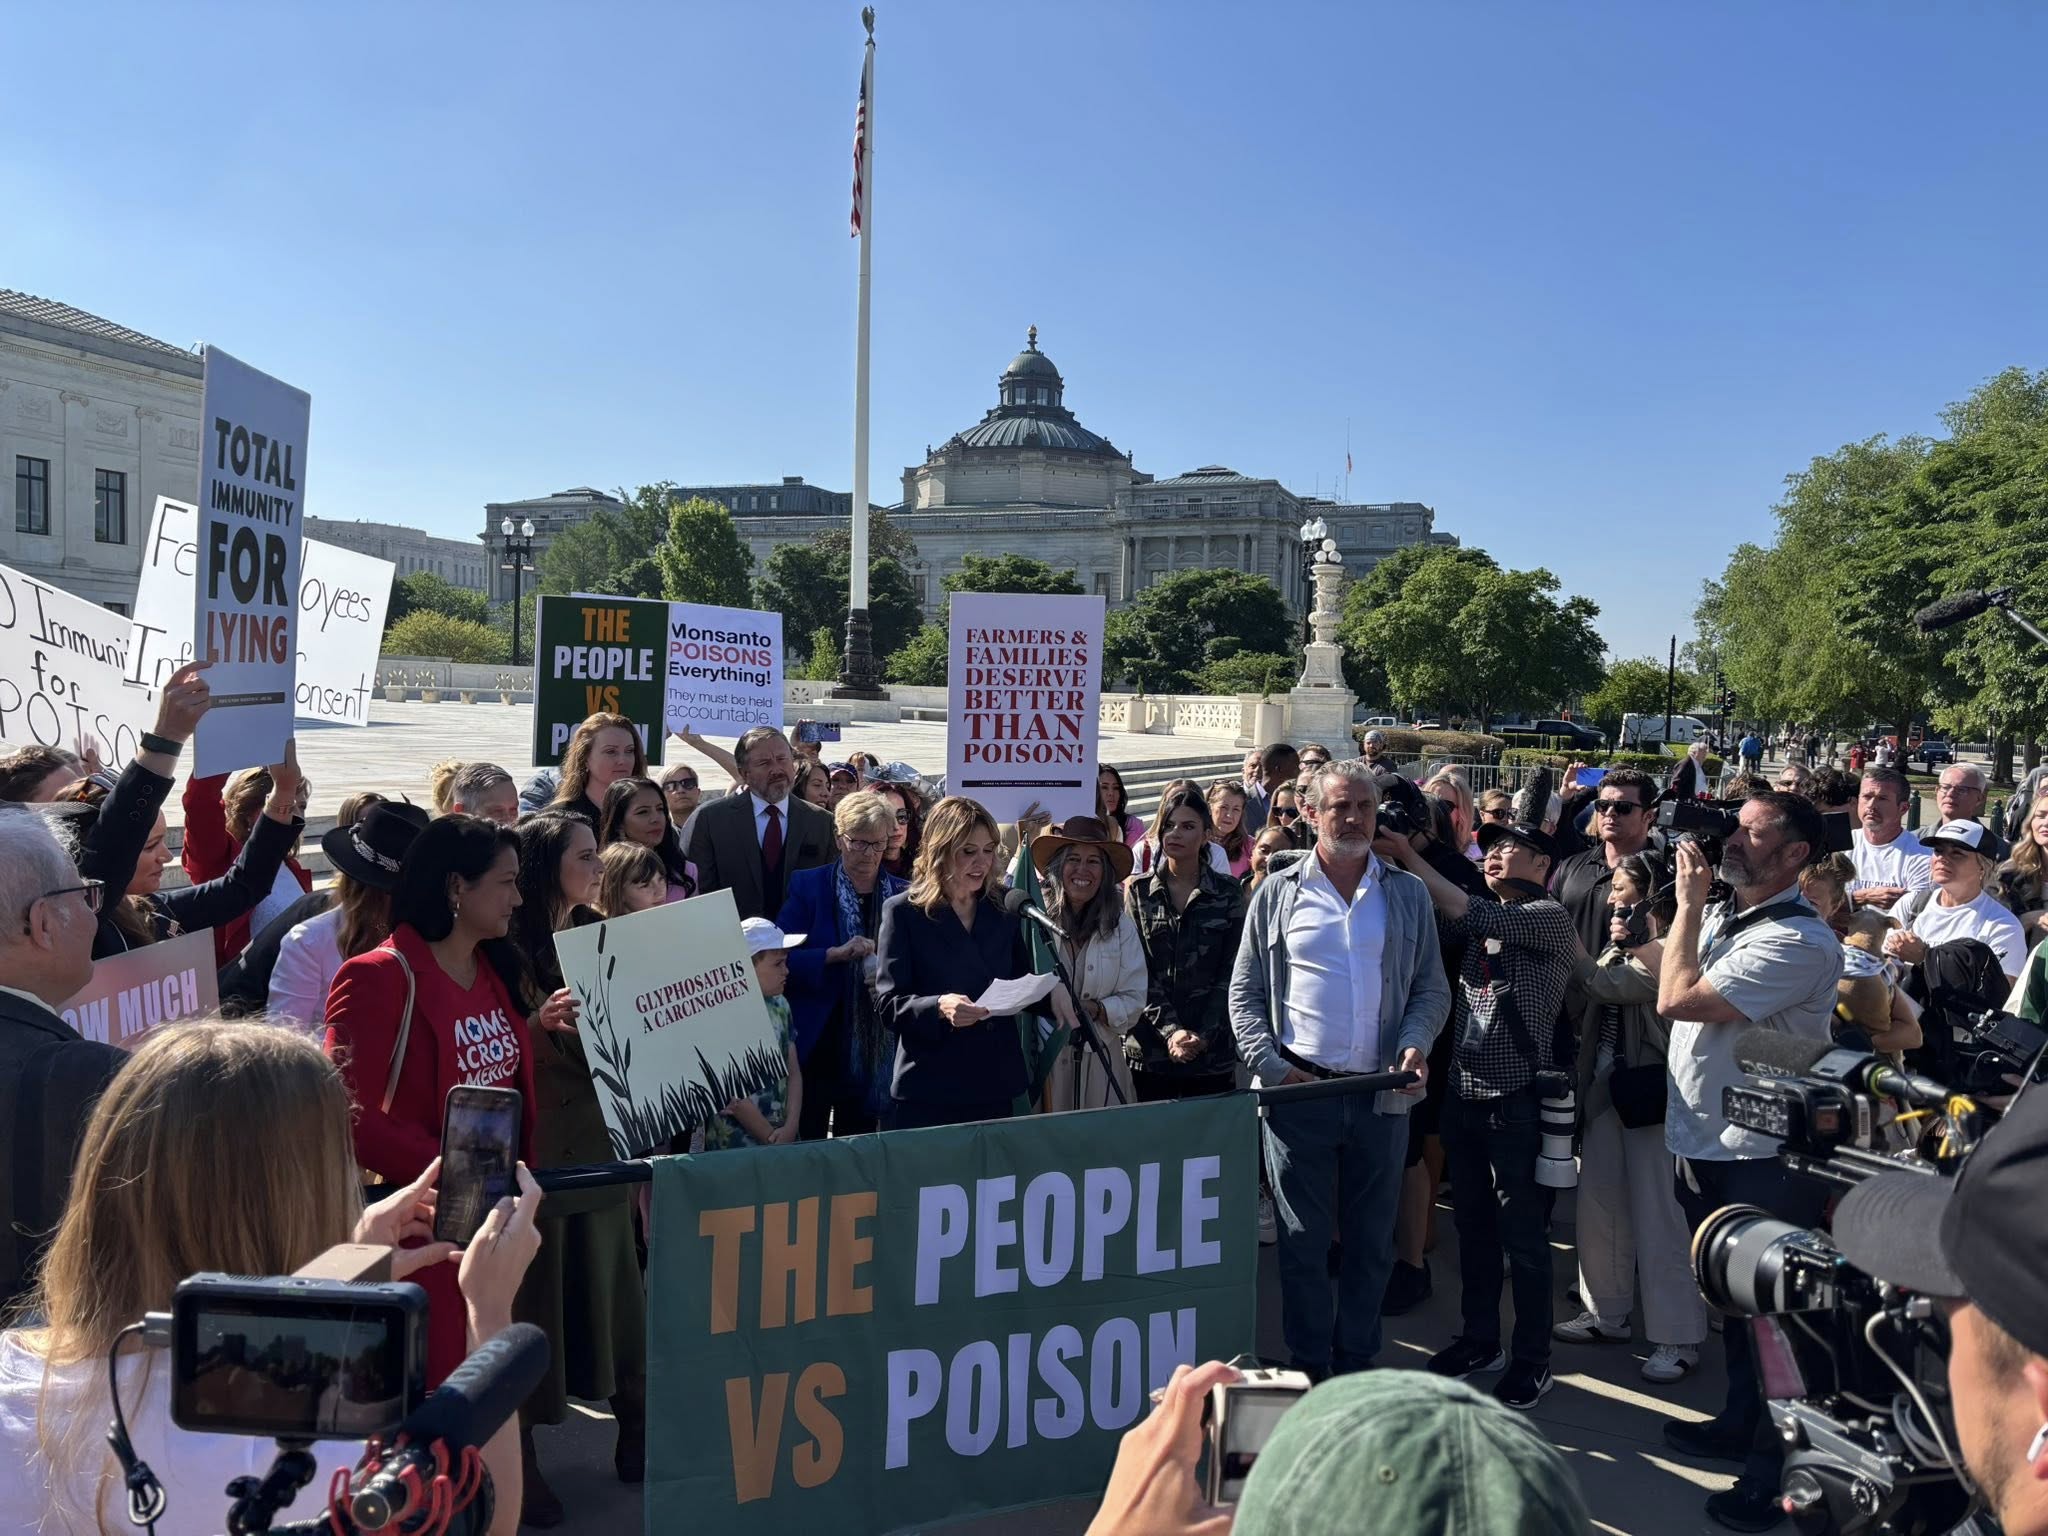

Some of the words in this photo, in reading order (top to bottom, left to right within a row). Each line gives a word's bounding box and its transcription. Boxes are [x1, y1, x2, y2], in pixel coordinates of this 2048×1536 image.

[215, 416, 296, 491] TOTAL
[211, 479, 294, 527] IMMUNITY
[208, 520, 289, 607] FOR
[22, 579, 129, 670] Immuni
[206, 610, 288, 664] LYING
[581, 607, 631, 643] THE
[671, 622, 771, 648] Monsanto
[966, 628, 1066, 645] FARMERS
[1071, 629, 1088, 645] &
[554, 645, 653, 681] PEOPLE
[670, 641, 772, 667] POISONS
[965, 647, 1088, 666] FAMILIES
[30, 650, 80, 702] for
[669, 661, 771, 687] Everything!
[965, 668, 1087, 687] DESERVE
[586, 685, 620, 716] VS
[667, 704, 773, 725] accountable.
[668, 688, 696, 703] They
[699, 693, 728, 704] must
[731, 693, 746, 705] be
[749, 695, 773, 708] held
[964, 689, 1085, 711] BETTER
[963, 713, 1085, 740] THAN
[963, 743, 1084, 764] POISON!
[635, 965, 730, 1014] GLYPHOSATE
[730, 960, 745, 979] IS
[59, 996, 110, 1044] OW
[118, 968, 199, 1039] MUCH
[643, 1016, 653, 1034] A
[654, 978, 750, 1028] CARCINGOGEN
[698, 1190, 878, 1335] THE
[914, 1155, 1222, 1306] PEOPLE
[724, 1361, 847, 1504] VS
[884, 1307, 1197, 1471] POISON
